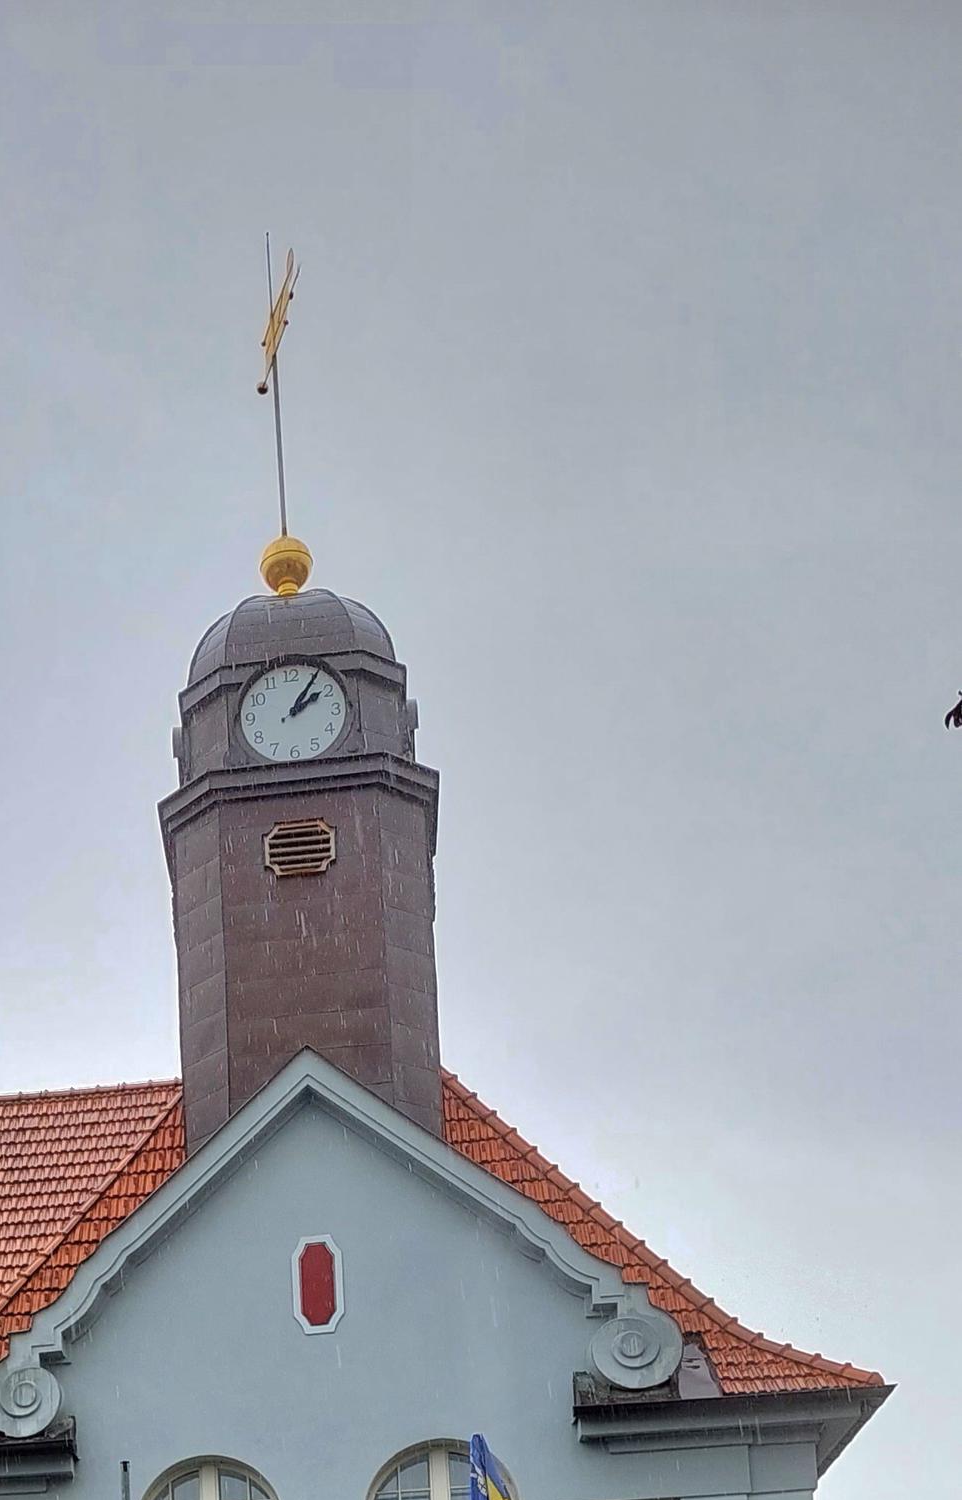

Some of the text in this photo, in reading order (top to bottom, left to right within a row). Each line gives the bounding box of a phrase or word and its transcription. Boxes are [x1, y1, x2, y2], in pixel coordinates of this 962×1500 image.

[283, 669, 299, 683] 12
[265, 677, 276, 690] 11
[323, 684, 333, 698] 2
[250, 692, 266, 707] 10
[331, 702, 341, 716] 3
[245, 712, 256, 726] 9
[324, 722, 335, 736] 4
[254, 731, 264, 744] 8
[310, 737, 320, 751] 5
[270, 743, 280, 756] 7
[290, 745, 300, 759] 6
